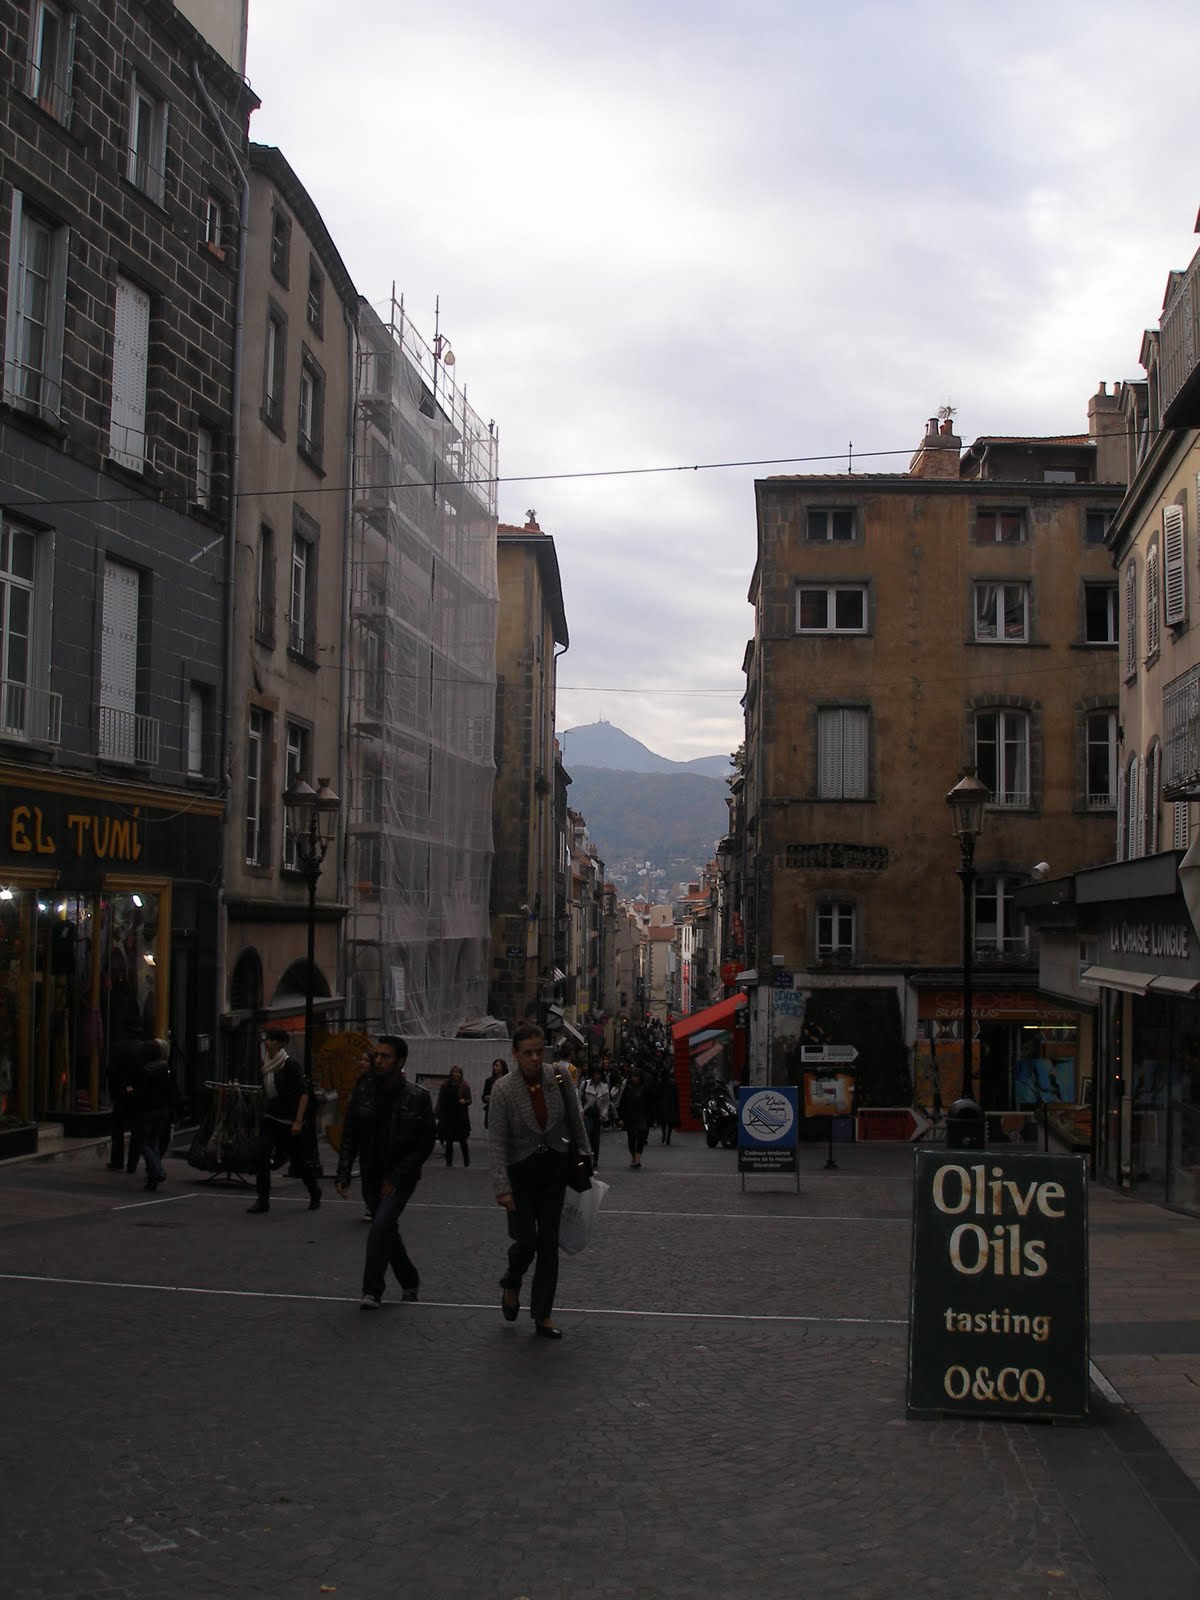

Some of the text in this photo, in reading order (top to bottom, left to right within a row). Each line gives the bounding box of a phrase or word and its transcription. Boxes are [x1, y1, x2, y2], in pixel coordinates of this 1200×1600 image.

[11, 804, 56, 854] EL
[1110, 921, 1188, 958] LA CHAISE LONGUE
[935, 1008, 1001, 1018] SURLUS
[931, 1164, 1066, 1218] Olive
[949, 1223, 1048, 1277] Oils
[944, 1307, 1053, 1342] tasting
[943, 1364, 1053, 1403] O&CO.
